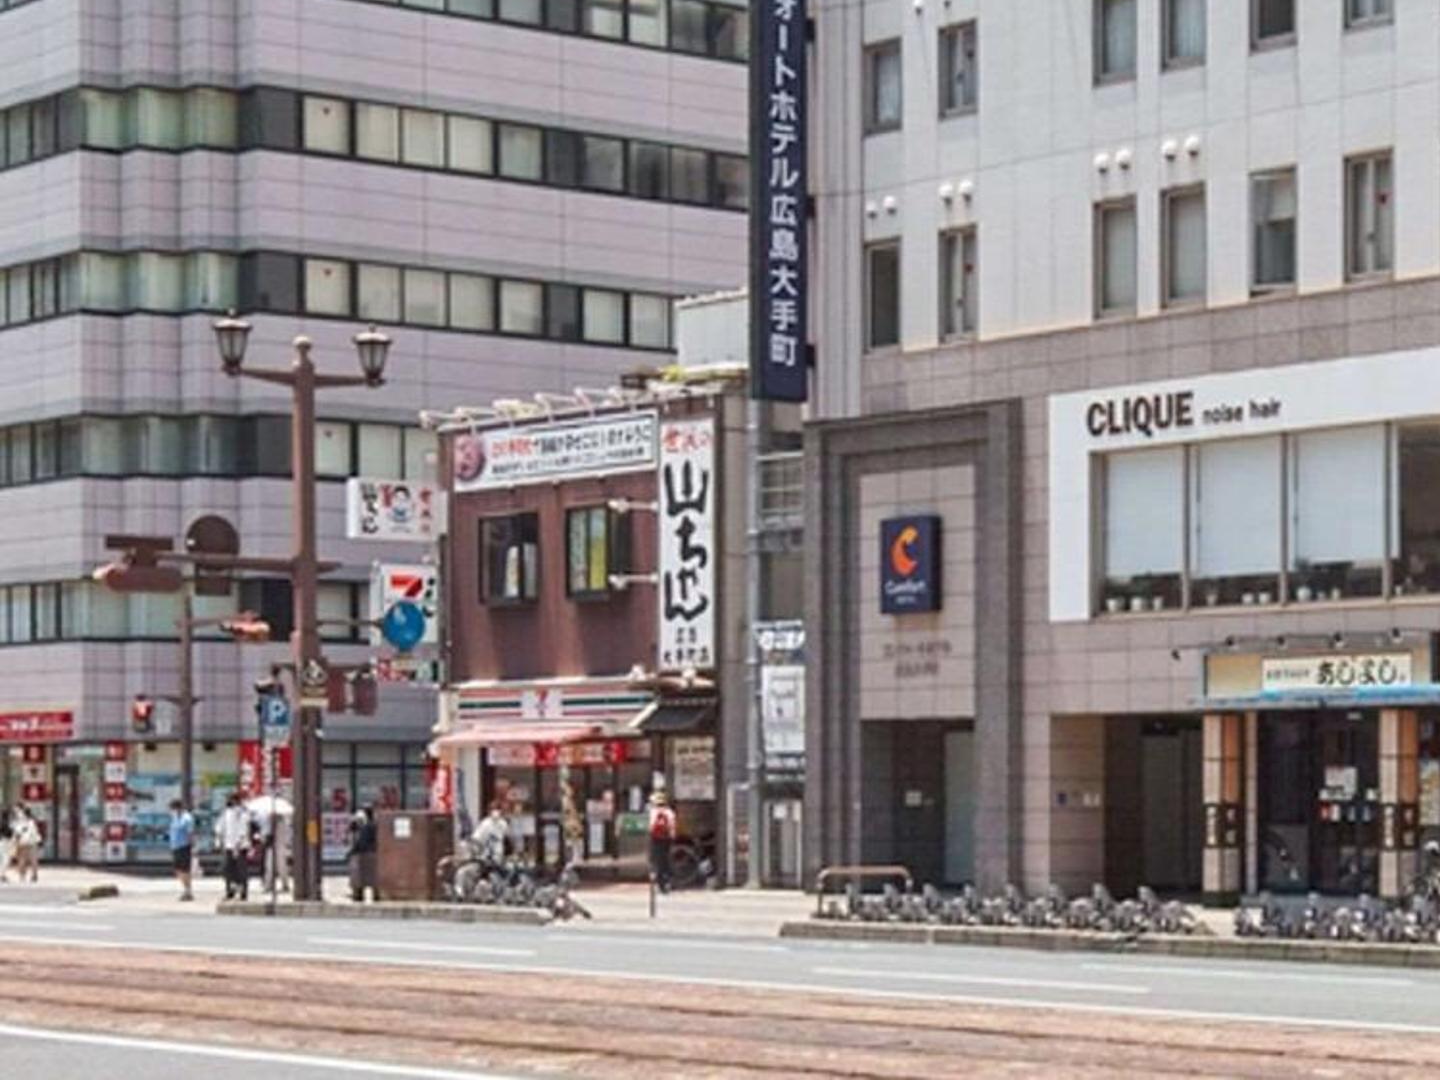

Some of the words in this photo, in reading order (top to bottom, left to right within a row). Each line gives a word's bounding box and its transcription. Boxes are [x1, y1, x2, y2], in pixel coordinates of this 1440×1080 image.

[1086, 391, 1195, 437] CLIQUE
[1202, 404, 1245, 425] noise
[1249, 397, 1282, 419] hair
